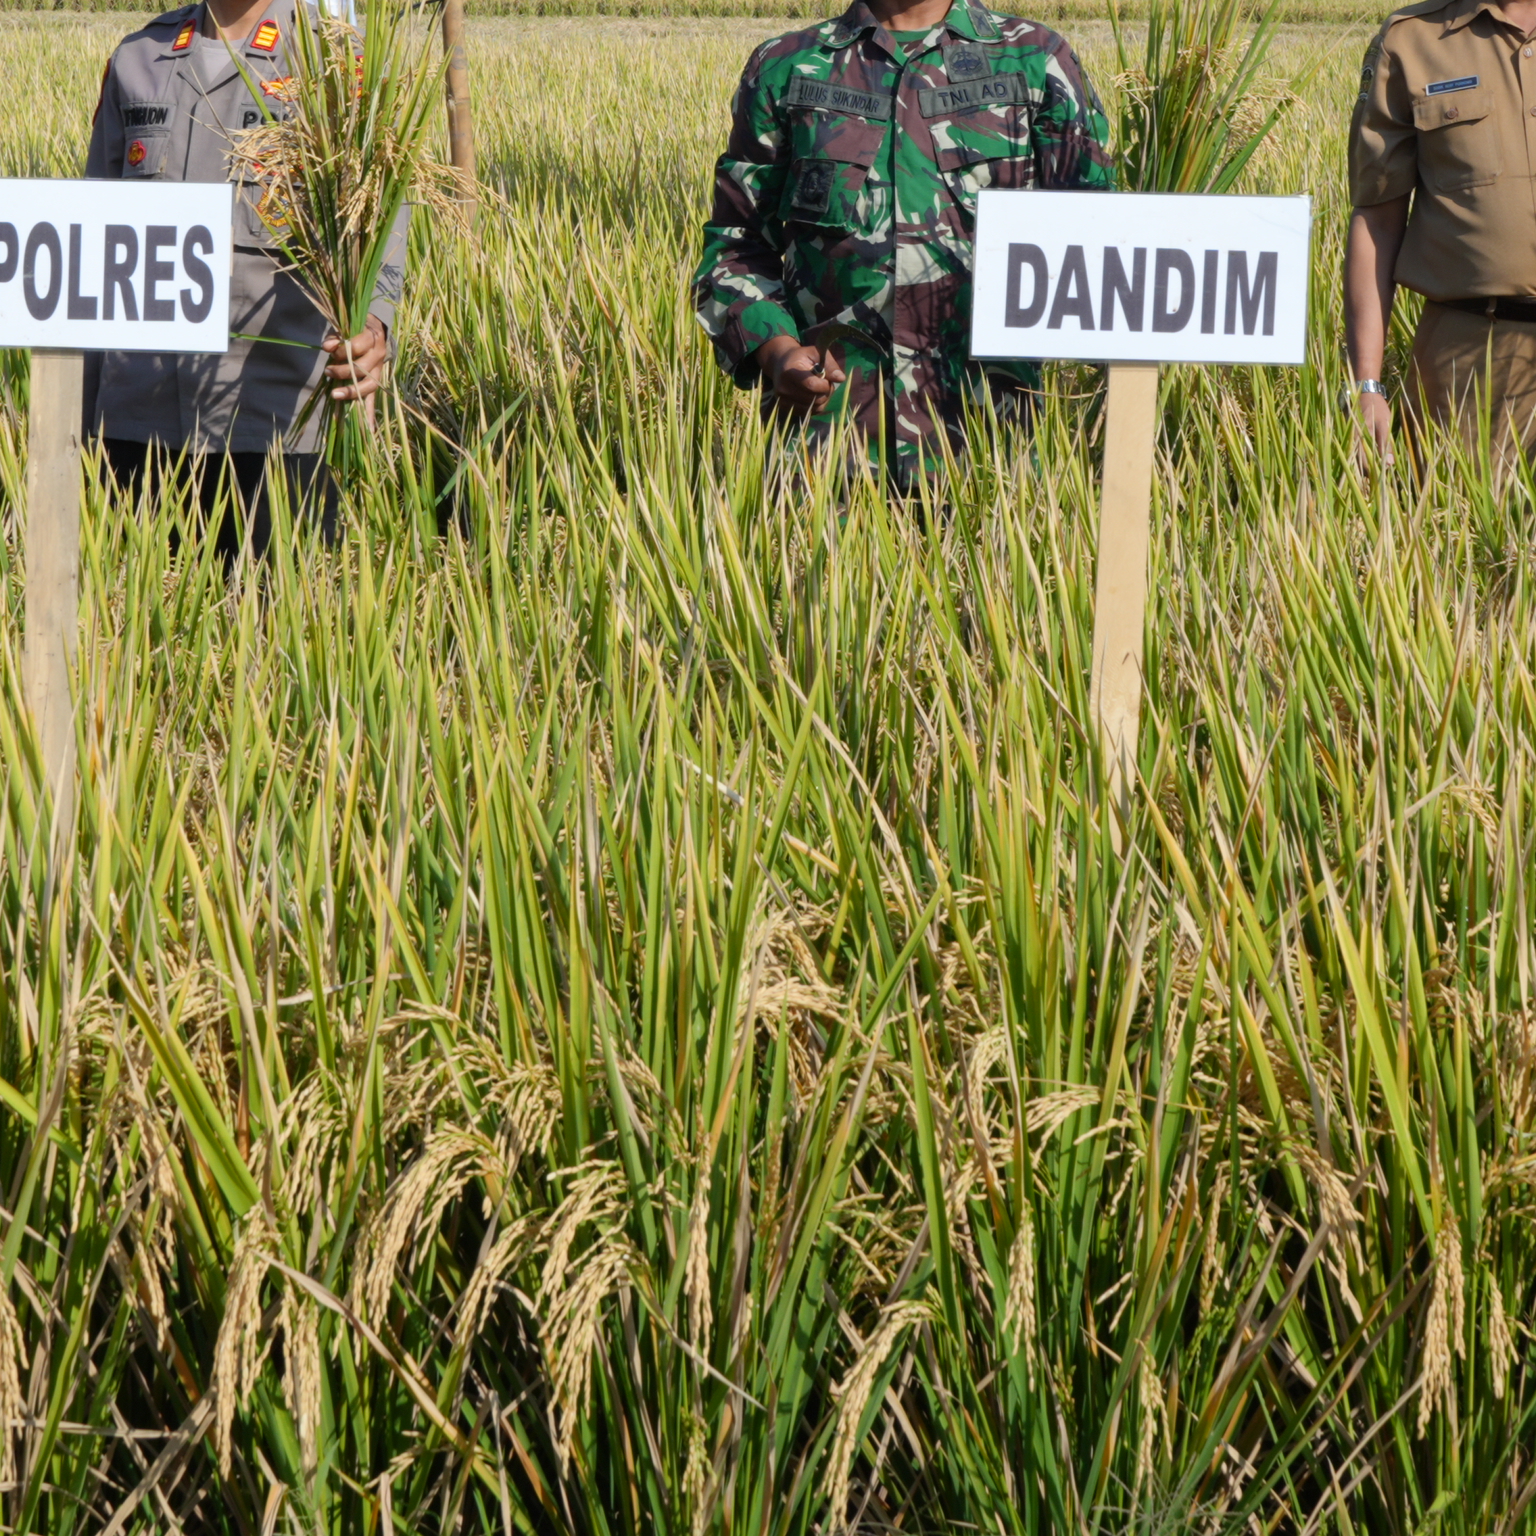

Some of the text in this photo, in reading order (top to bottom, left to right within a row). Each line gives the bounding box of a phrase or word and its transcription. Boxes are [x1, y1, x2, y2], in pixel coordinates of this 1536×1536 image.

[799, 85, 880, 113] LULUS SUKINDAR
[938, 82, 1009, 108] TNI AD
[1005, 243, 1279, 336] DANDIM
